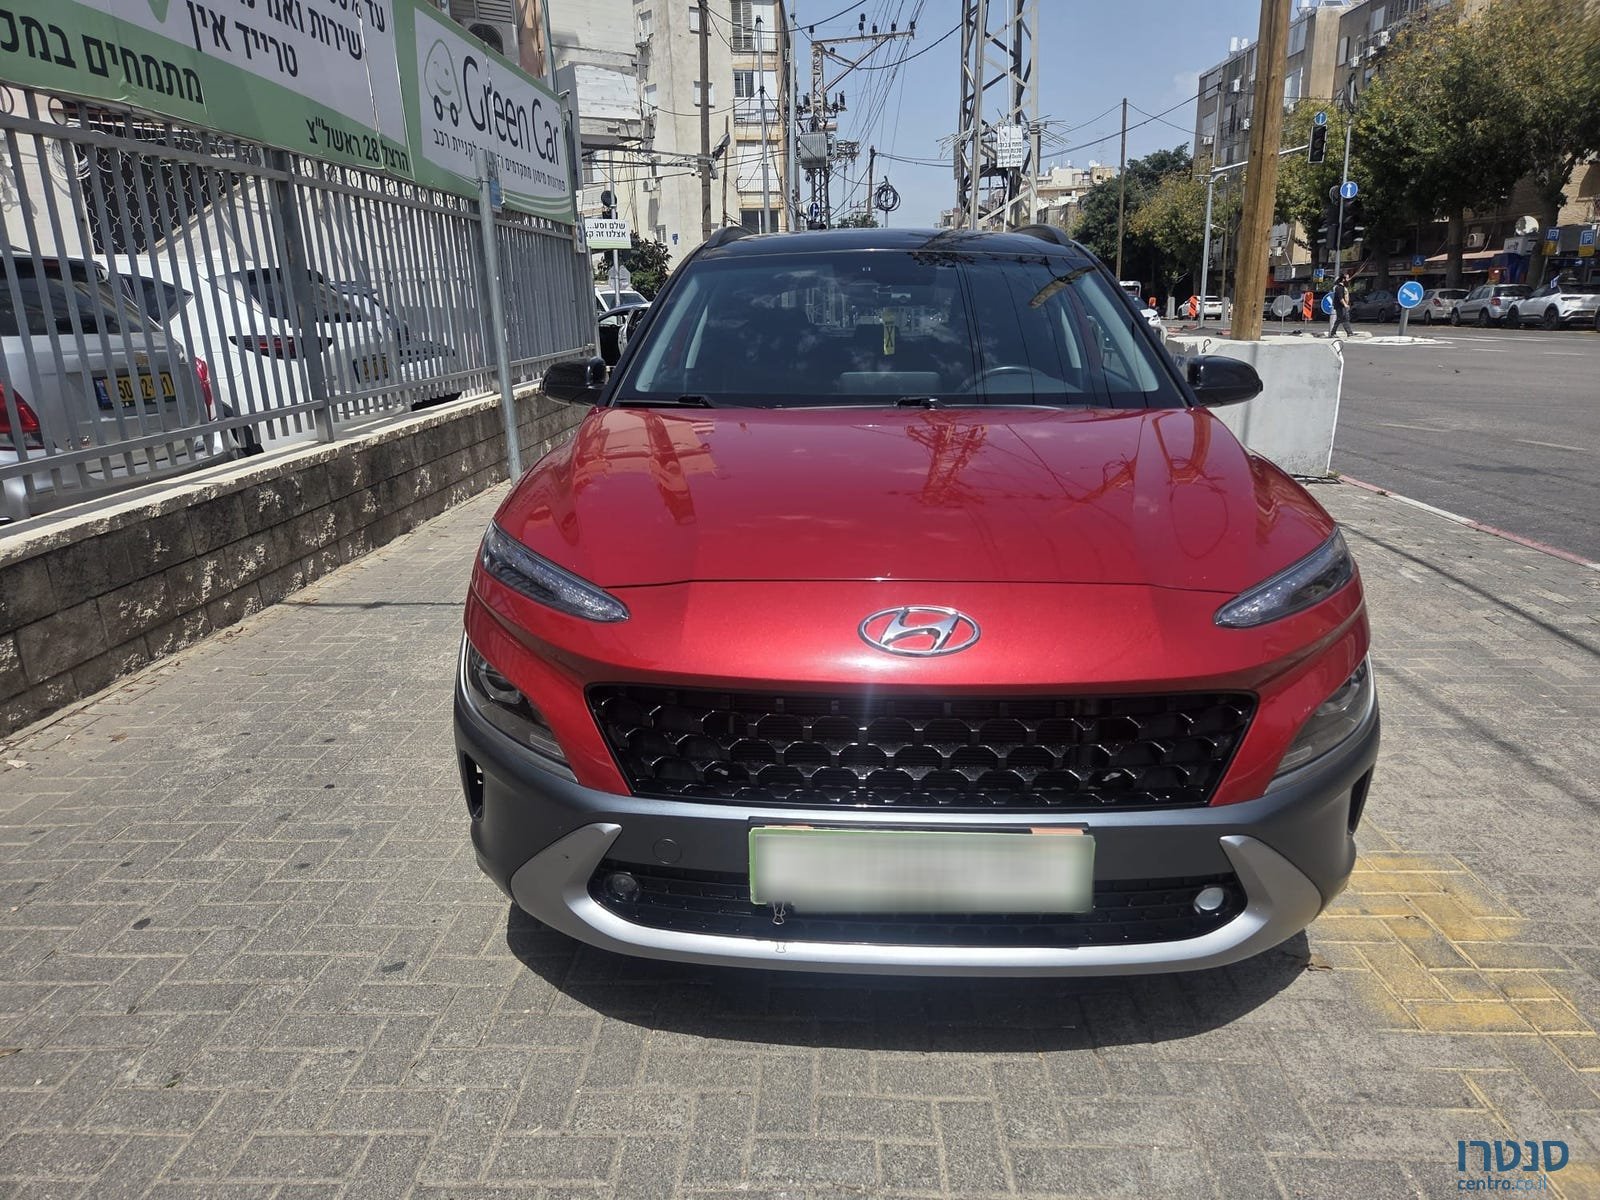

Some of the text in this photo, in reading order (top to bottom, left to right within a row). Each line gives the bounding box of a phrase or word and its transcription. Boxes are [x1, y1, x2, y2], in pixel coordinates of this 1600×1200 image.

[365, 0, 385, 32] עד
[187, 0, 298, 77] טרייד אין
[308, 7, 362, 60] שירות
[82, 34, 204, 104] מתמחים
[463, 55, 560, 167] Green Car
[363, 134, 380, 163] 28
[433, 128, 450, 149] רכב
[381, 139, 409, 172] הרצל
[596, 230, 604, 238] זה
[606, 229, 626, 238] אצלנו
[608, 221, 625, 230] שלם
